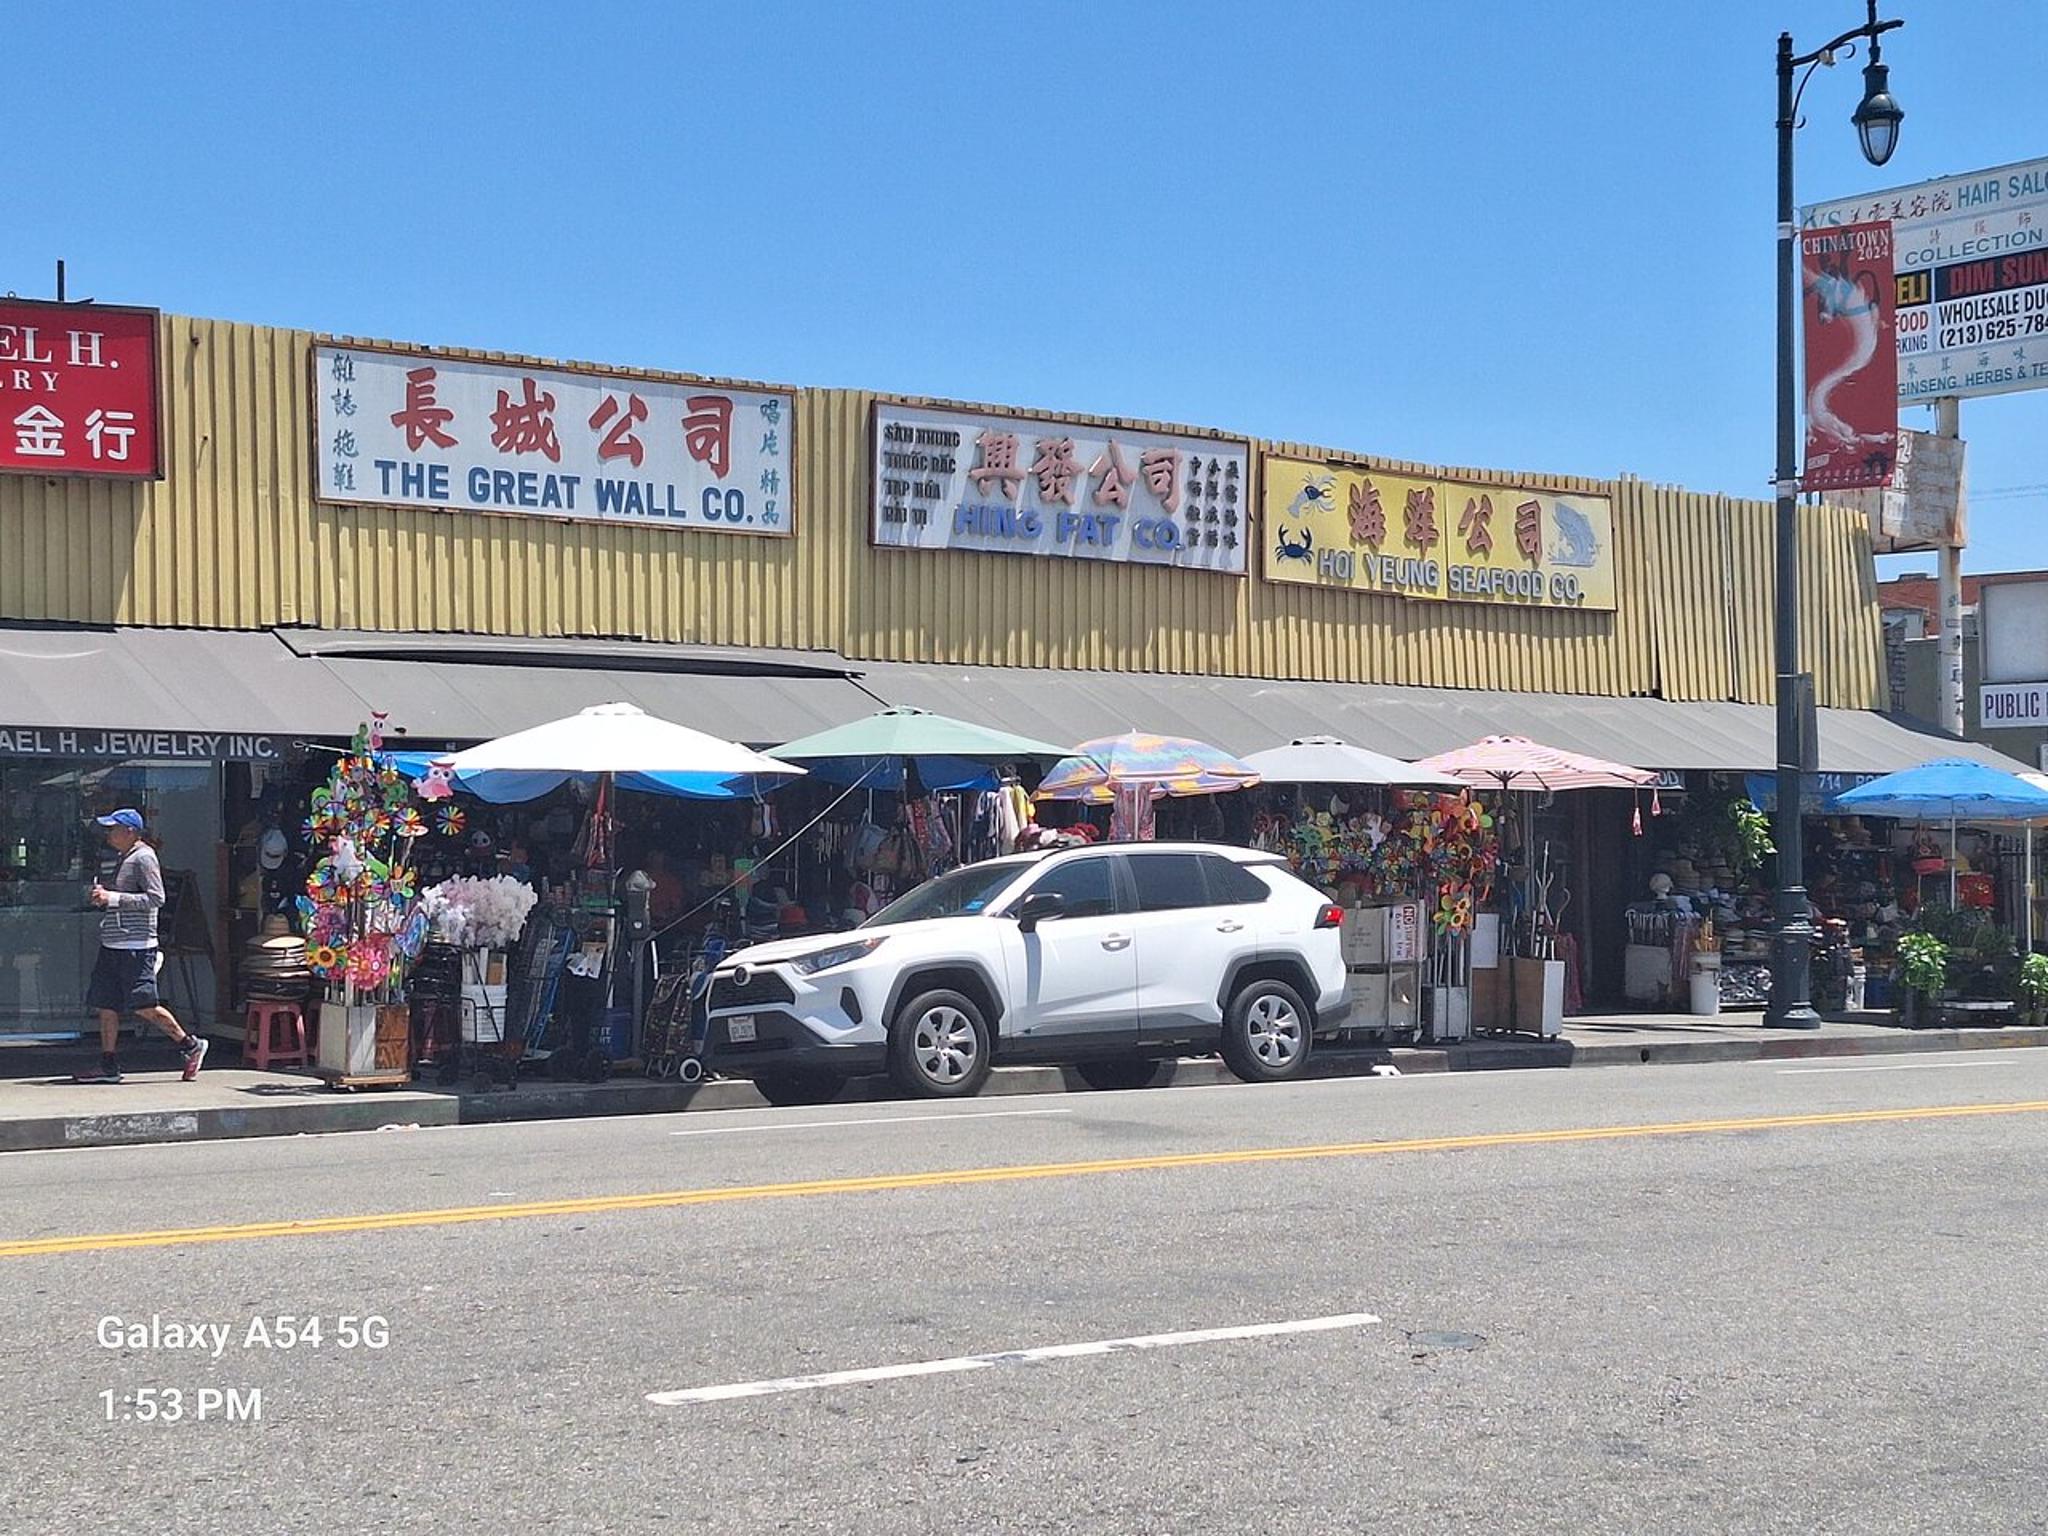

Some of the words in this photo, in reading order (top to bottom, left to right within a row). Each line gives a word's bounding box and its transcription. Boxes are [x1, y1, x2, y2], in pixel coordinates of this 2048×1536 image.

[1957, 180, 2000, 208] HAIR
[1803, 228, 1891, 255] CHINATOWN
[1857, 246, 1890, 261] 2024
[1905, 228, 2043, 265] COLLECTION
[1896, 273, 1928, 304] ELI
[1948, 262, 1995, 296] DIM
[1896, 311, 1929, 333] OOD
[1939, 293, 2020, 326] WHOLESALE
[2024, 288, 2048, 312] DU
[67, 330, 120, 369] H.
[0, 369, 60, 392] RY
[1965, 367, 2013, 387] HERBS
[14, 404, 136, 460] 金行
[390, 366, 736, 479] 長城公司
[374, 459, 449, 500] THE
[468, 466, 581, 509] GREAT
[596, 478, 686, 518] WALL
[701, 487, 754, 523] CO.
[954, 503, 1043, 540] HING
[1057, 511, 1120, 546] FAT
[1133, 517, 1187, 551] CO.
[1319, 548, 1356, 580] HOI
[1363, 553, 1439, 587] YEUNG
[1449, 565, 1545, 598] SEAFOOD
[1985, 691, 2040, 719] PUBLIC
[59, 732, 85, 754] H.
[94, 733, 222, 756] JEWELRY
[229, 736, 279, 758] INC.
[1818, 773, 1841, 790] 714
